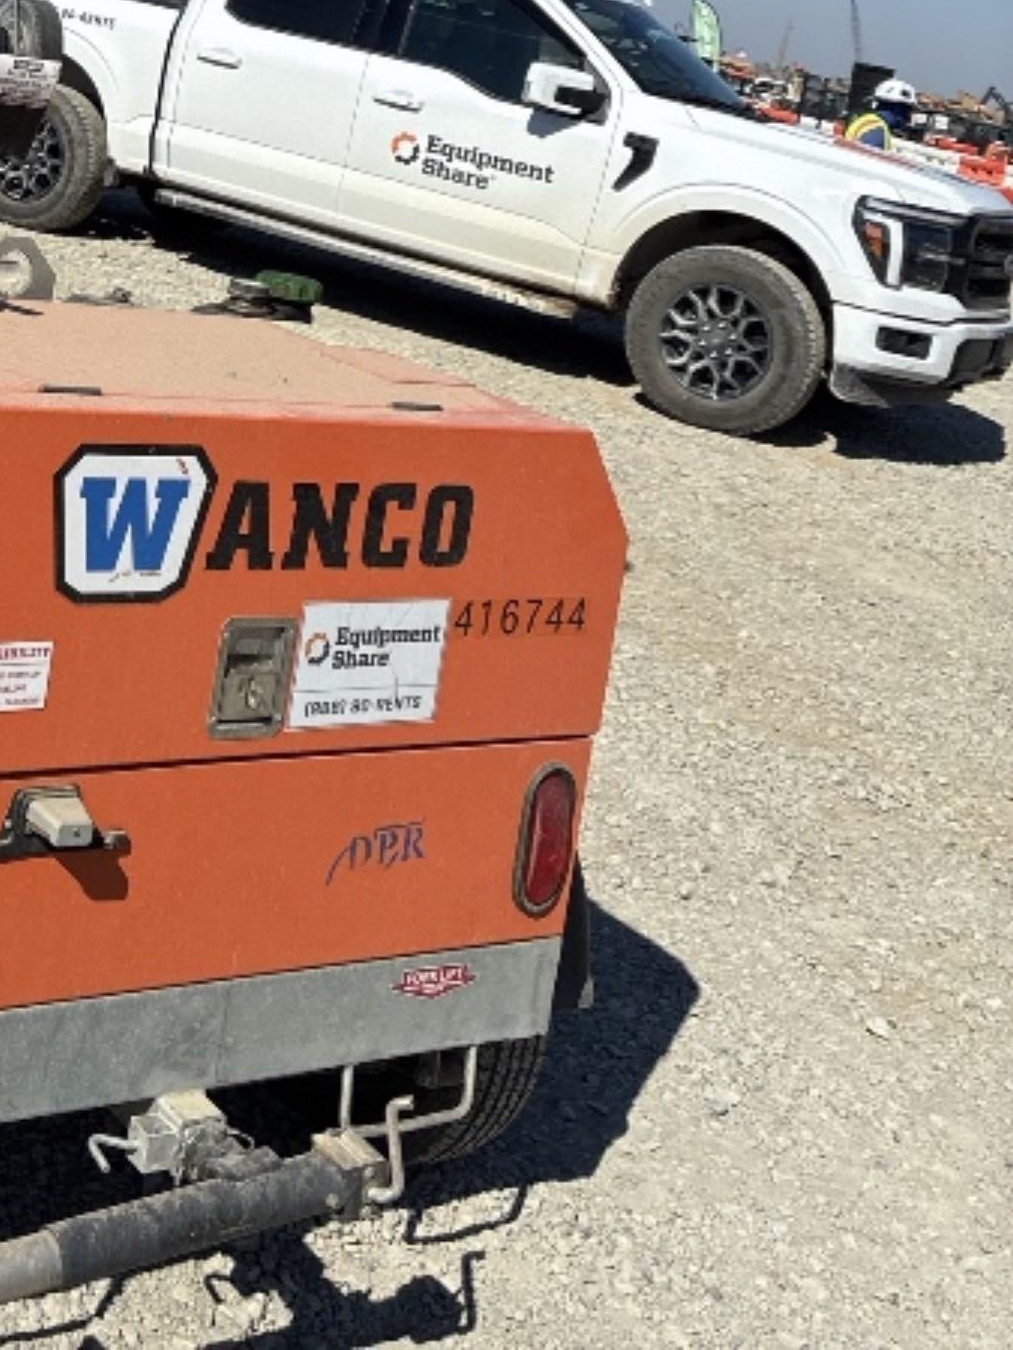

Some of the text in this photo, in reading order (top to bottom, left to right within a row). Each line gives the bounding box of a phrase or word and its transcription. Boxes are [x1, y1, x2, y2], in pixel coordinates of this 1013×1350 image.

[421, 158, 490, 190] Share
[425, 134, 555, 184] Equipment
[80, 476, 474, 572] WANCO
[454, 597, 586, 637] 416744
[335, 626, 440, 649] Equipment
[332, 651, 390, 670] Share
